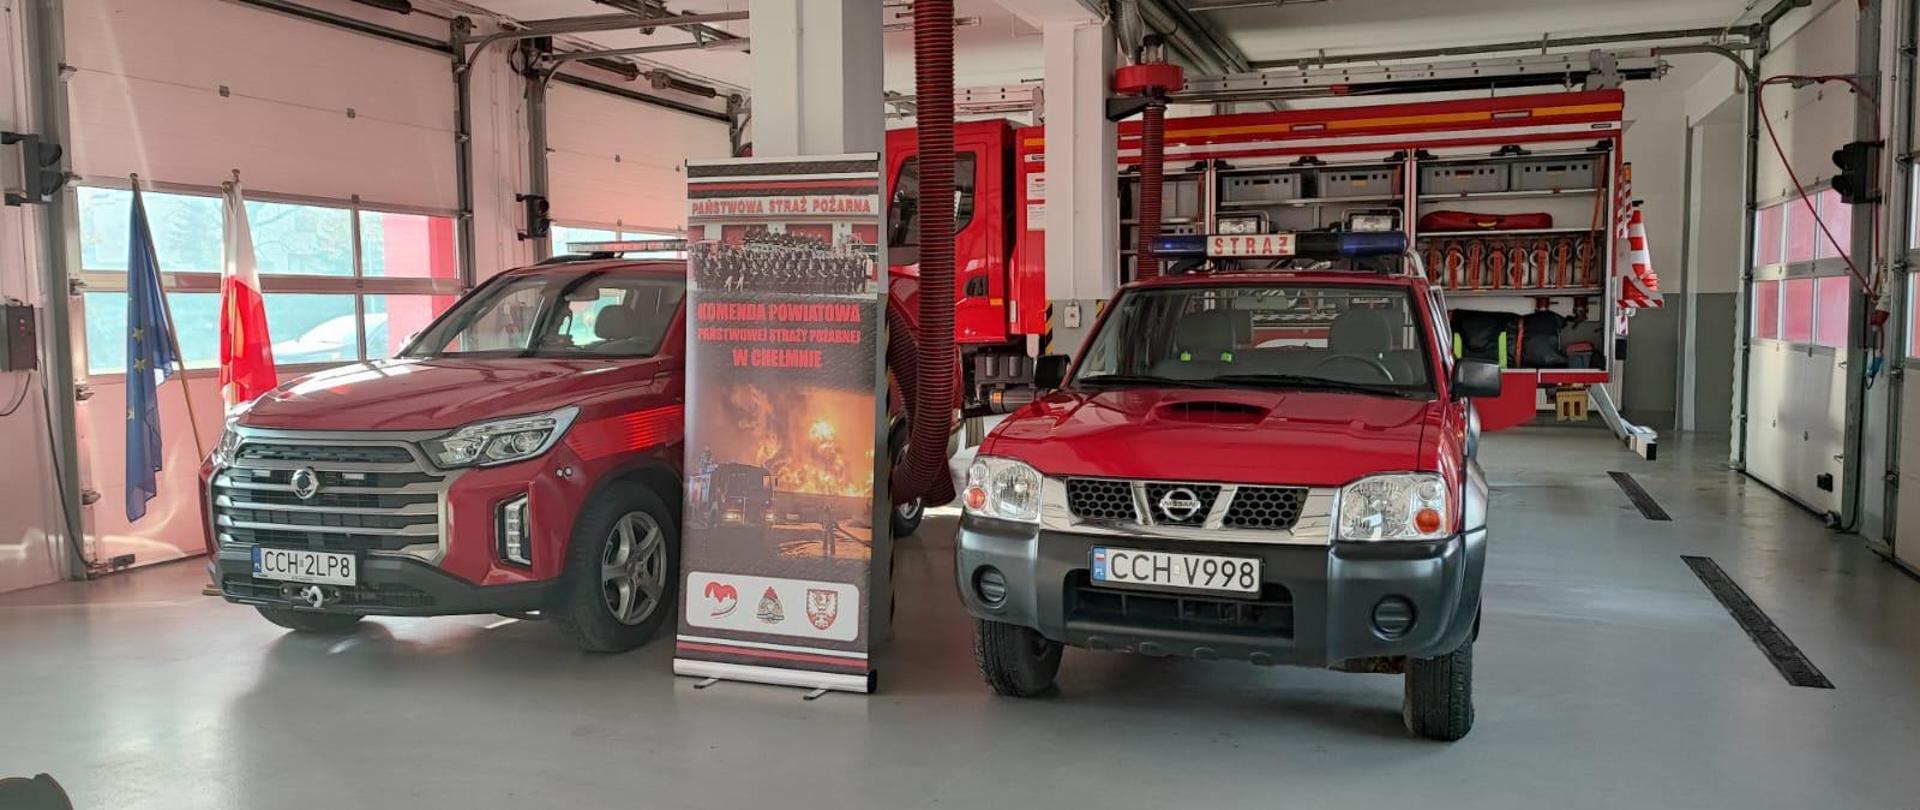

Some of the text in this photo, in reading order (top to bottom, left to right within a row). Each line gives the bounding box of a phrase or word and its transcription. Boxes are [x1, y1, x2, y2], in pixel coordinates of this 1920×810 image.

[768, 197, 808, 212] STRAŻ
[812, 197, 871, 212] POŻARNA
[698, 303, 861, 322] KOMENDA POWIATOWA
[698, 326, 861, 344] PAŃSTWOWEJ STRAŻY POŻARNEJ
[733, 349, 748, 367] W
[1161, 499, 1199, 508] NISSAN
[265, 551, 350, 578] CCH 2LP8
[1111, 553, 1255, 589] CCH V998
